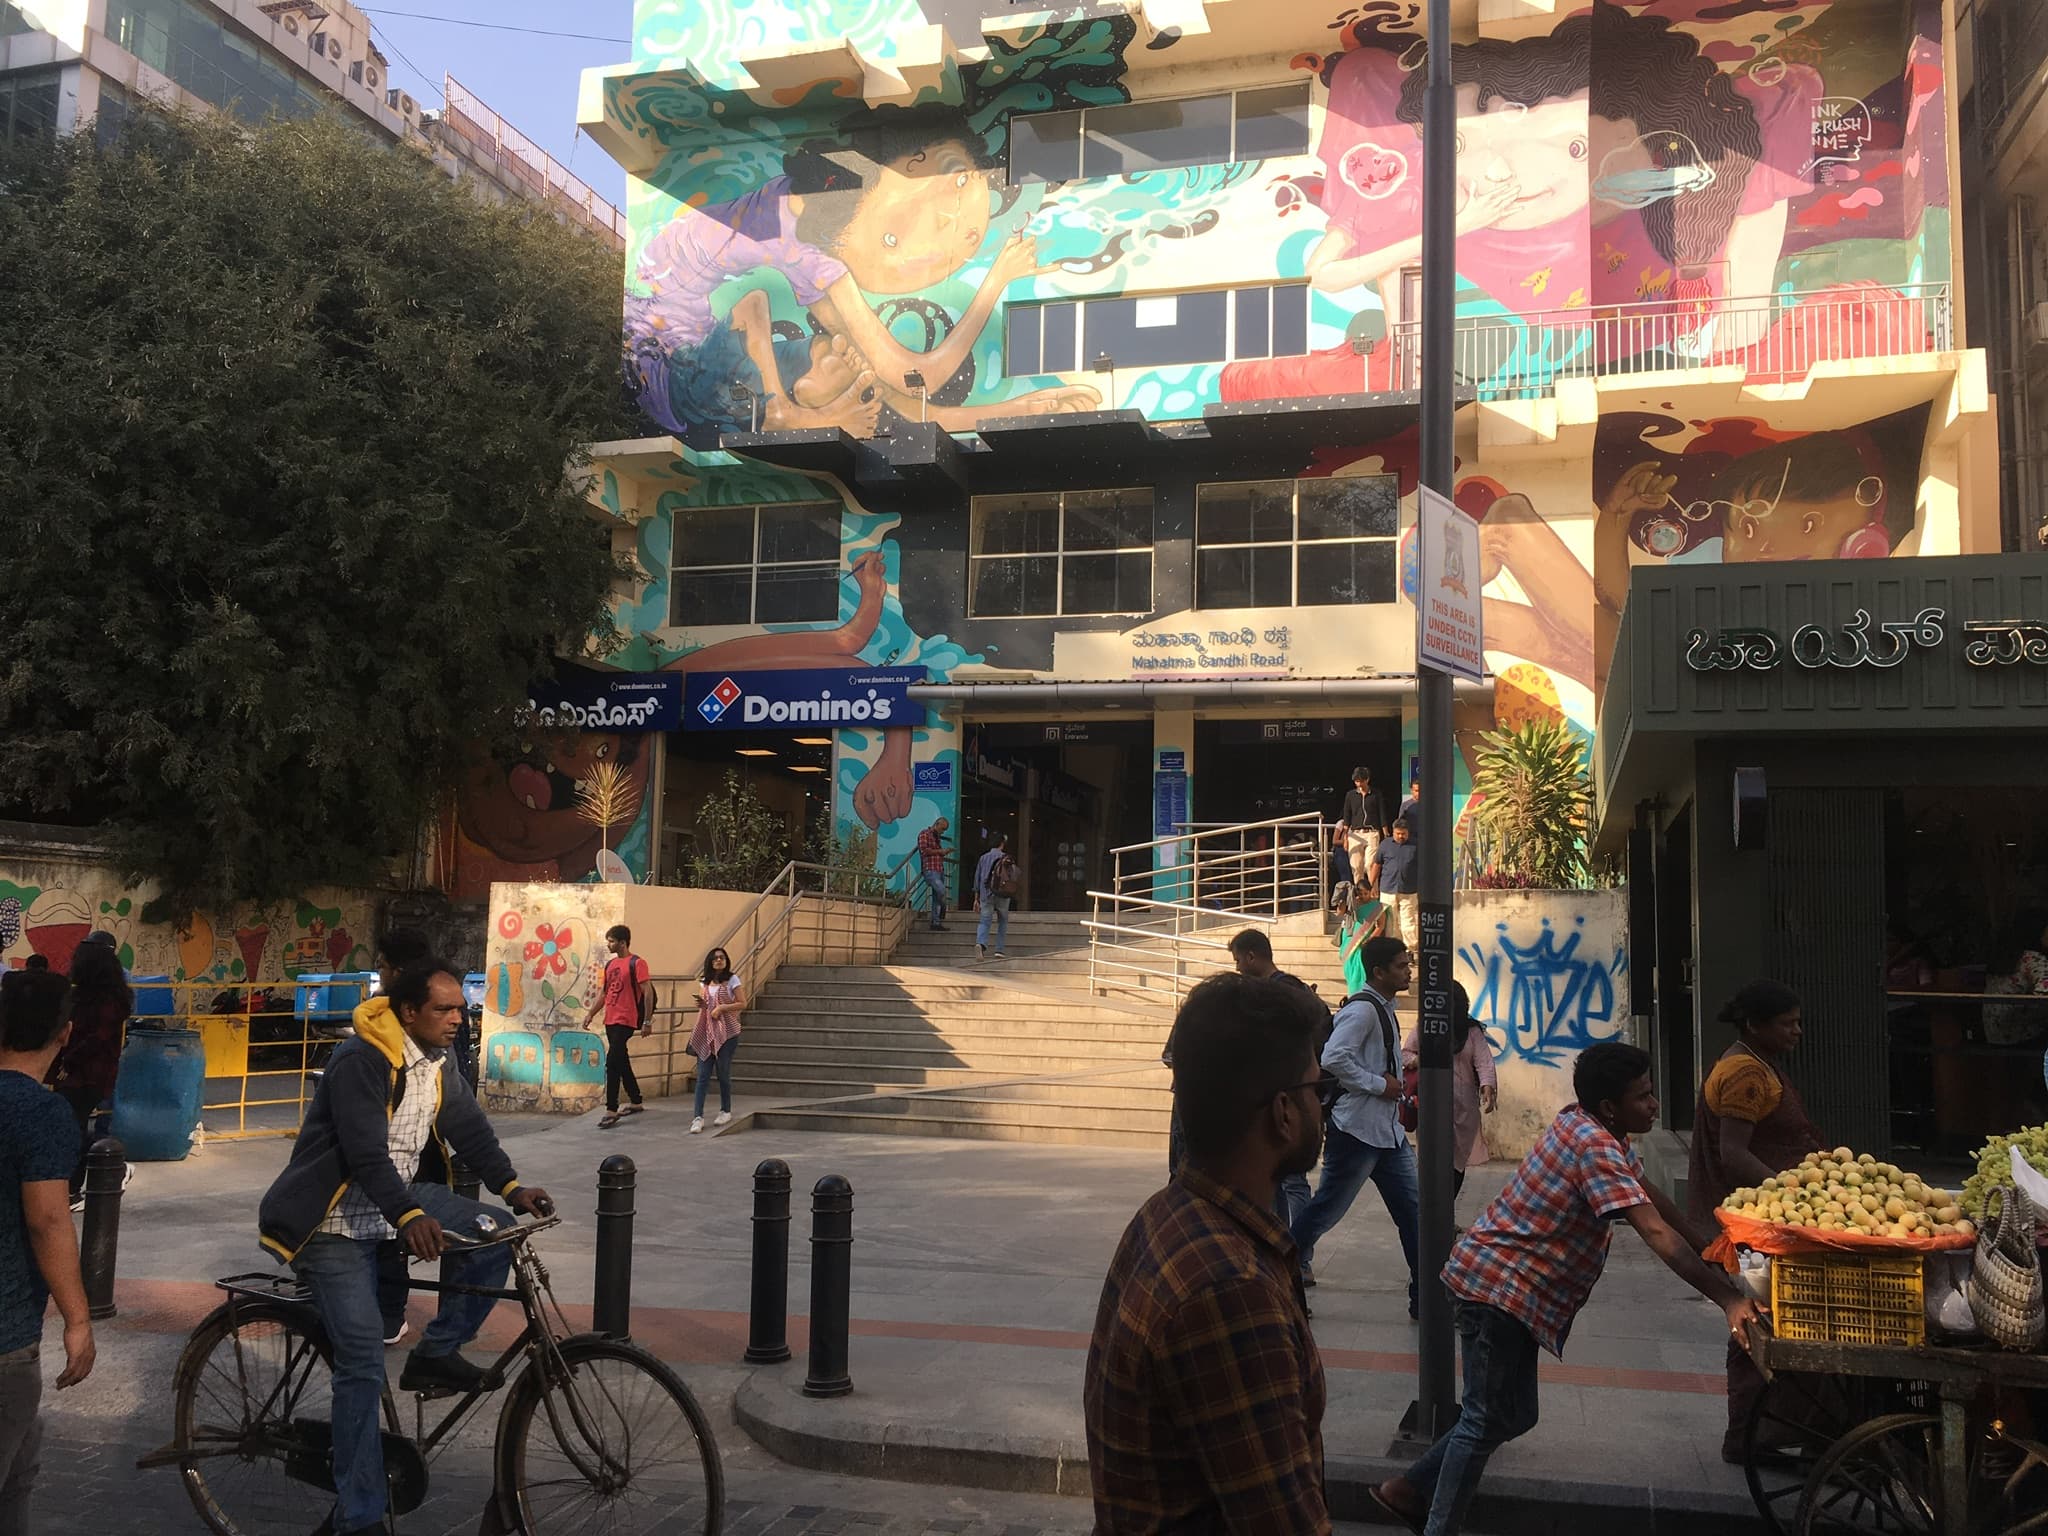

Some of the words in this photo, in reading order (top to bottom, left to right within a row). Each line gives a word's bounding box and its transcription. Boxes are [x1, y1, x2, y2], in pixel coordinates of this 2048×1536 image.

[1811, 104, 1842, 119] INK
[1811, 117, 1861, 135] BRUSH
[1431, 599, 1449, 616] THIS
[1450, 606, 1468, 624] AREA
[1468, 613, 1476, 628] IS
[1264, 626, 1289, 650] ರಸ್ತೆ
[1428, 616, 1457, 639] UNDER
[1458, 628, 1477, 646] CCTV
[1425, 634, 1479, 665] SURVEILLANCE
[1132, 656, 1196, 670] Mahatma
[1199, 653, 1248, 668] Gandhi
[1250, 652, 1286, 667] Road
[743, 689, 892, 722] Domino's
[1421, 912, 1445, 926] SMS
[1423, 1020, 1449, 1034] LED
